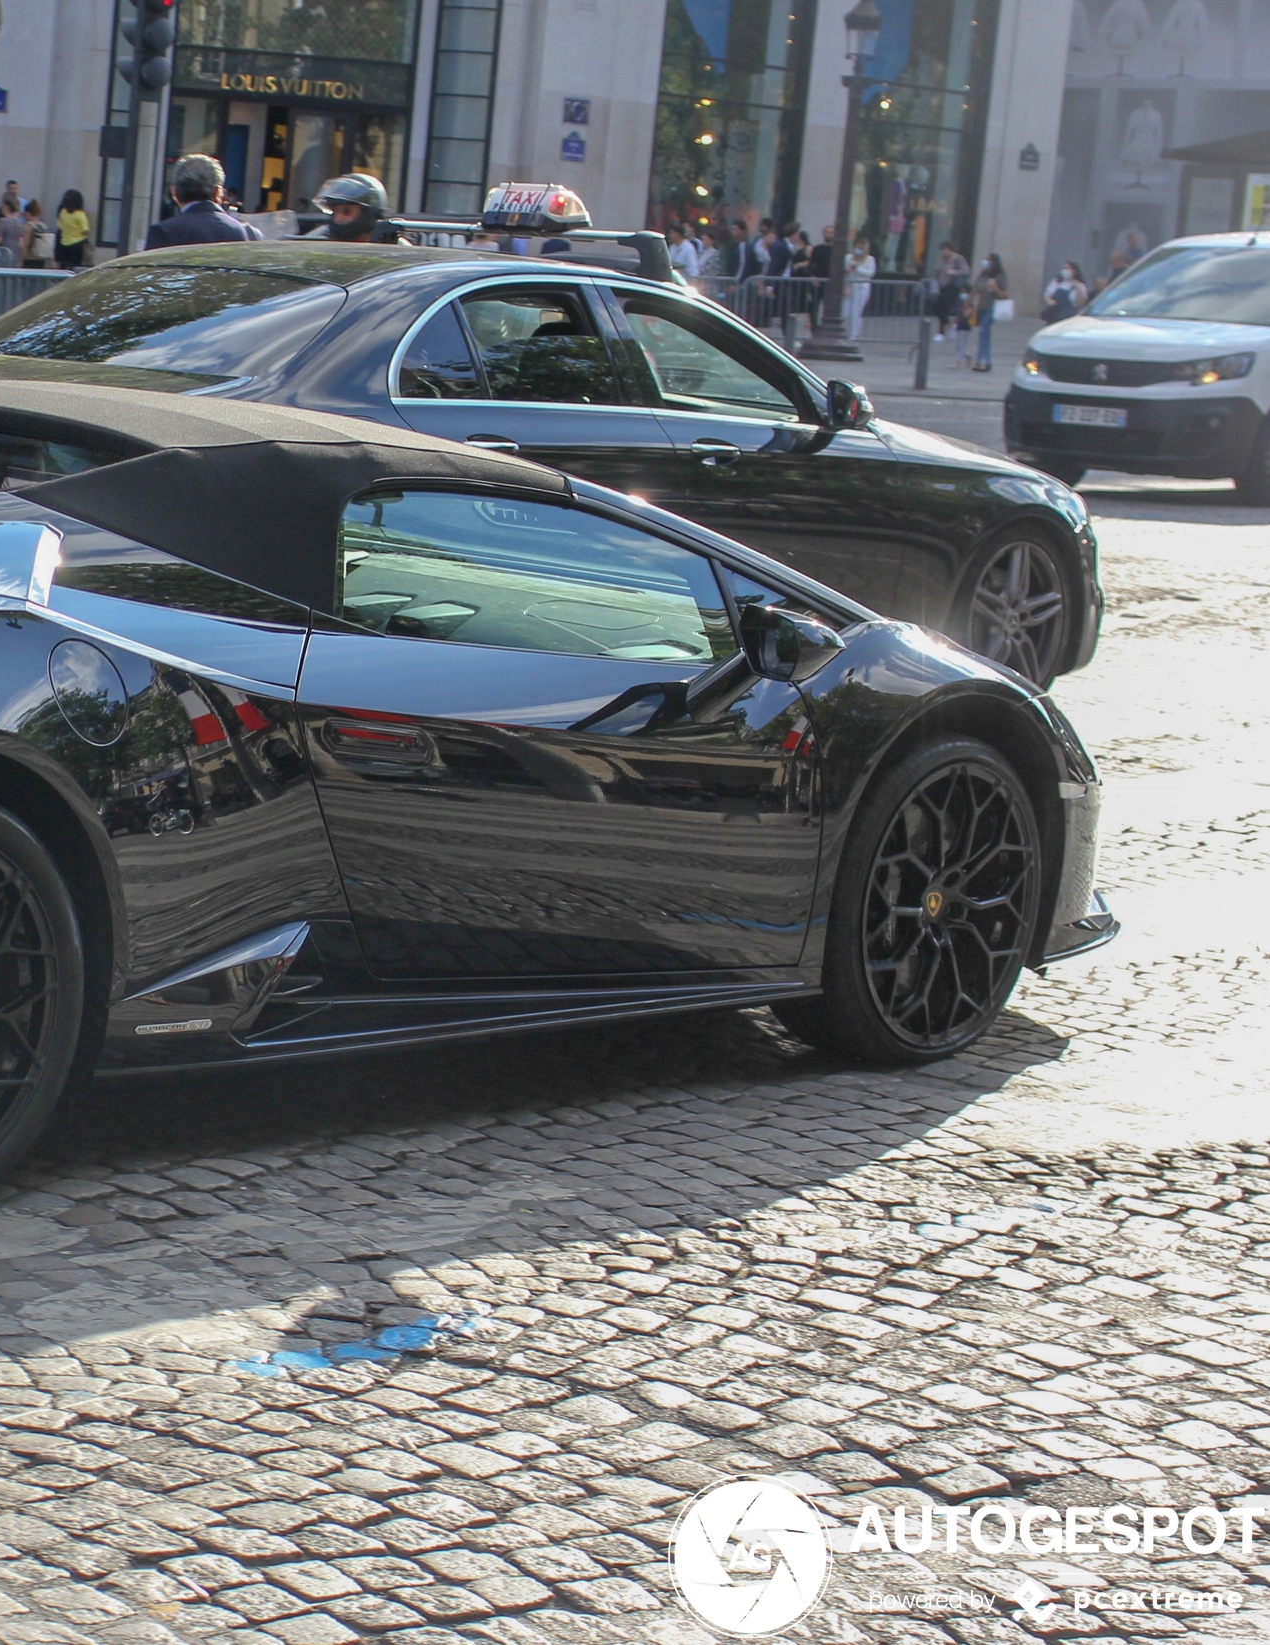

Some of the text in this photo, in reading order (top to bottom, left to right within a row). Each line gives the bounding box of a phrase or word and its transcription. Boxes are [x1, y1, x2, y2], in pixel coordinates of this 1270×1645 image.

[220, 73, 364, 99] LOUIS VUITTON
[503, 190, 544, 206] TAXI
[493, 202, 543, 213] PARISIEN
